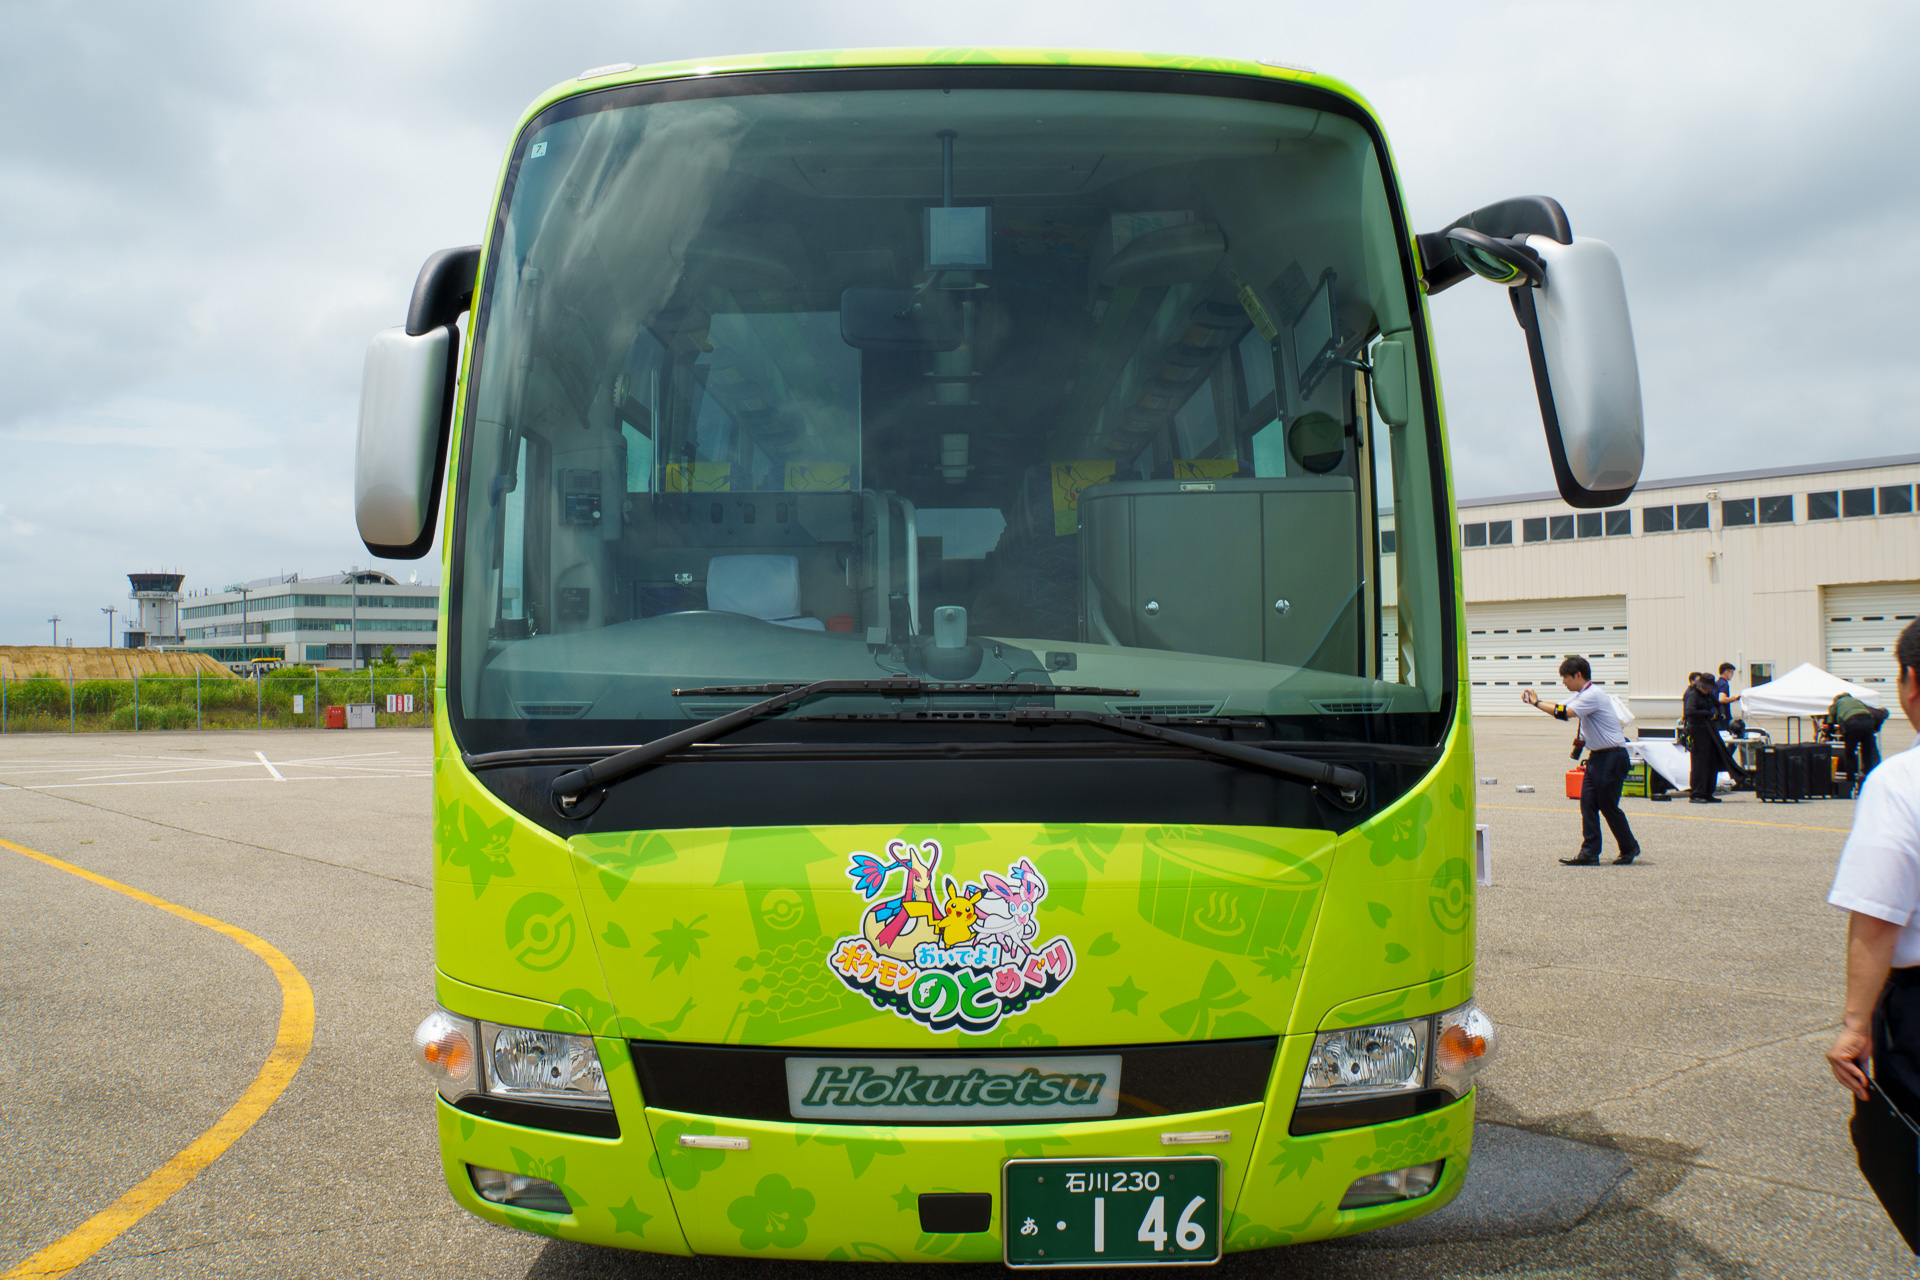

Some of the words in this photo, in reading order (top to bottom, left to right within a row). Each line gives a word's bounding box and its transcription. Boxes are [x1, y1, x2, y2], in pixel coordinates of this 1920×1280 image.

[918, 947, 998, 966] おいでよ!
[801, 1066, 1107, 1106] Hokutetsu
